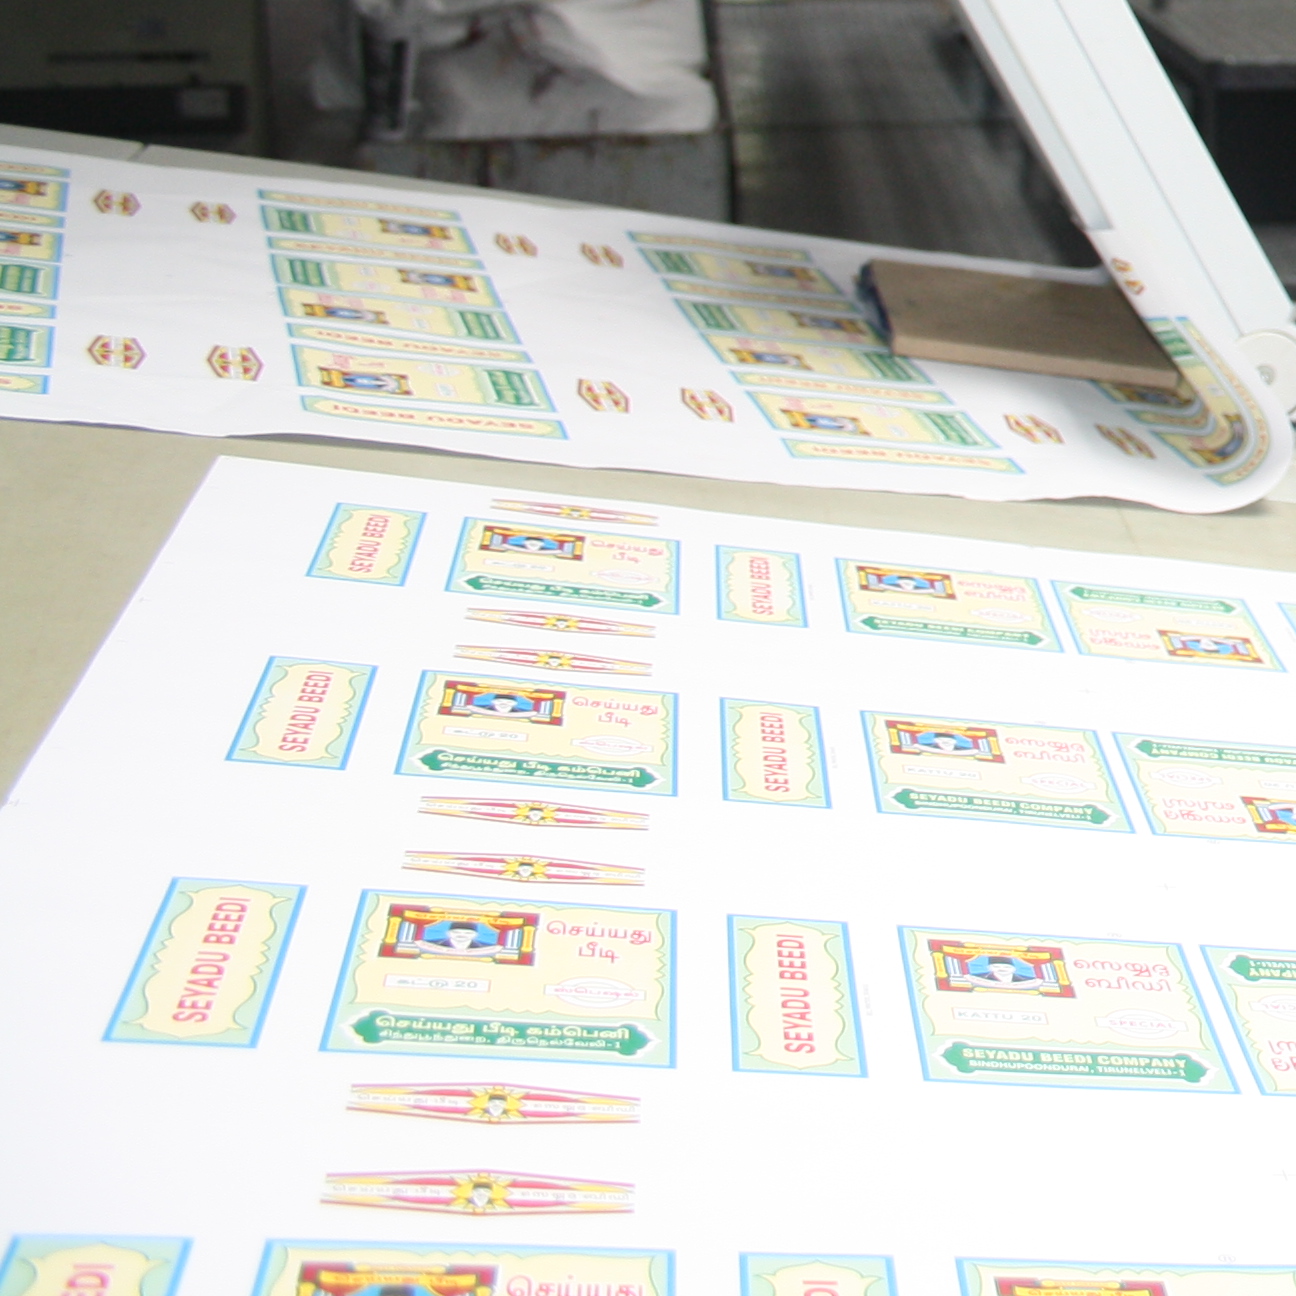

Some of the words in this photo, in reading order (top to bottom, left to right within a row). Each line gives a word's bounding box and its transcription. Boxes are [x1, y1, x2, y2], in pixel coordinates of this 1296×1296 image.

[333, 404, 415, 420] BEEDI
[428, 416, 534, 430] SEYADU
[360, 513, 391, 538] BEEDI
[346, 538, 382, 573] SEYADU
[748, 556, 771, 580] BEEDI
[749, 581, 774, 615] SEYADU
[296, 670, 335, 703] BEEDI
[276, 705, 322, 753] SEYADU
[759, 712, 786, 744] BEEDI
[761, 746, 791, 792] SEYADU
[908, 793, 967, 804] SEYADU
[971, 798, 1014, 808] BEEDI
[1017, 802, 1094, 814] COMPANY
[200, 896, 252, 946] BEEDI
[775, 933, 809, 980] BEEDI
[169, 951, 233, 1024] SEYADU
[778, 985, 816, 1055] SEYADU
[956, 1010, 1014, 1020] KATTU
[1020, 1014, 1043, 1022] 20
[1107, 1018, 1177, 1029] SPECIAL
[961, 1048, 1035, 1061] SEYADU
[1039, 1052, 1093, 1064] BEEDI
[1095, 1055, 1189, 1068] COMPANY
